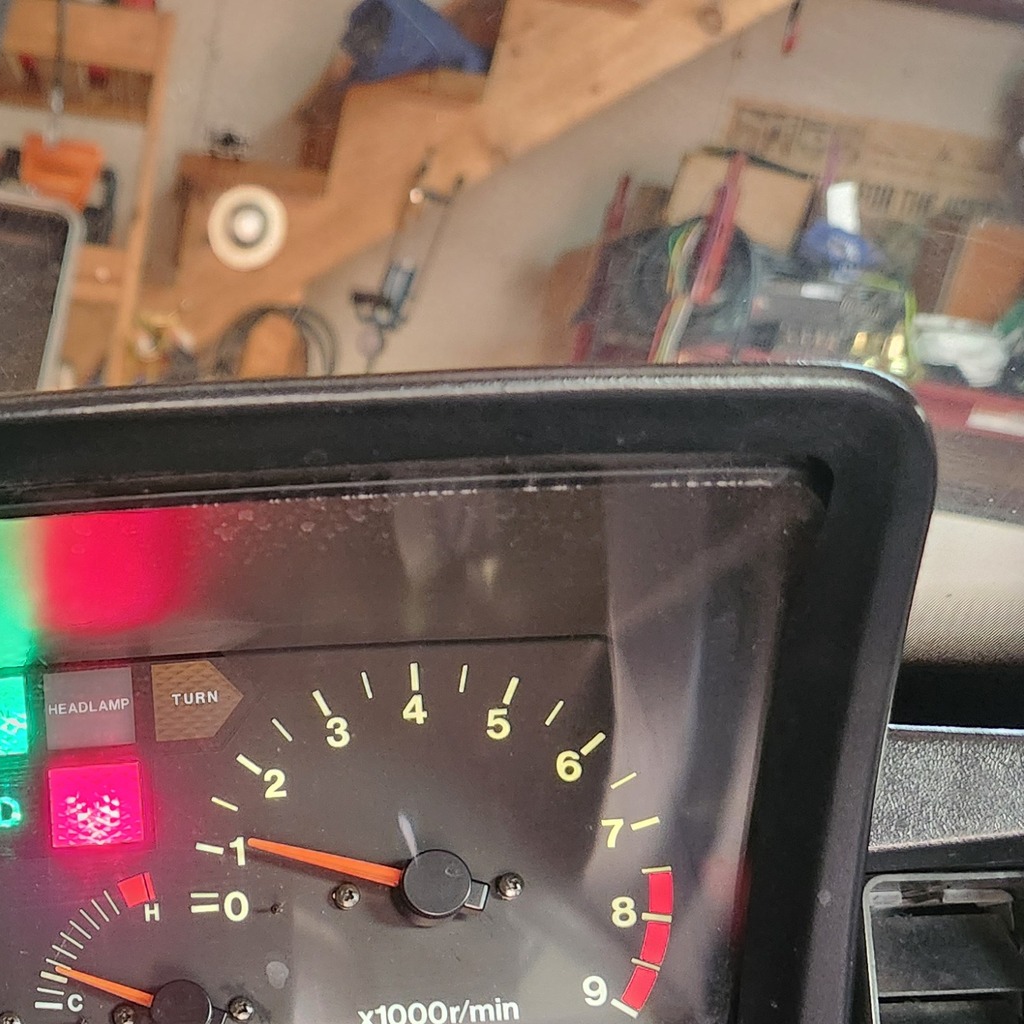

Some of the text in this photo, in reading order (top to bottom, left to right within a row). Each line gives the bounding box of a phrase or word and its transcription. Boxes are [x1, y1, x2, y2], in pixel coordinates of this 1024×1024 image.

[48, 698, 130, 716] HEADLAMP
[172, 690, 218, 706] TURN
[402, 694, 428, 725] 4
[325, 717, 351, 748] 3
[486, 709, 512, 740] 5
[555, 750, 582, 782] 6
[263, 770, 287, 799] 2
[601, 818, 624, 848] 7
[228, 837, 246, 866] 1
[144, 904, 160, 922] H
[223, 891, 250, 921] 0
[611, 897, 637, 927] 8
[67, 993, 84, 1013] C
[582, 976, 608, 1006] 9
